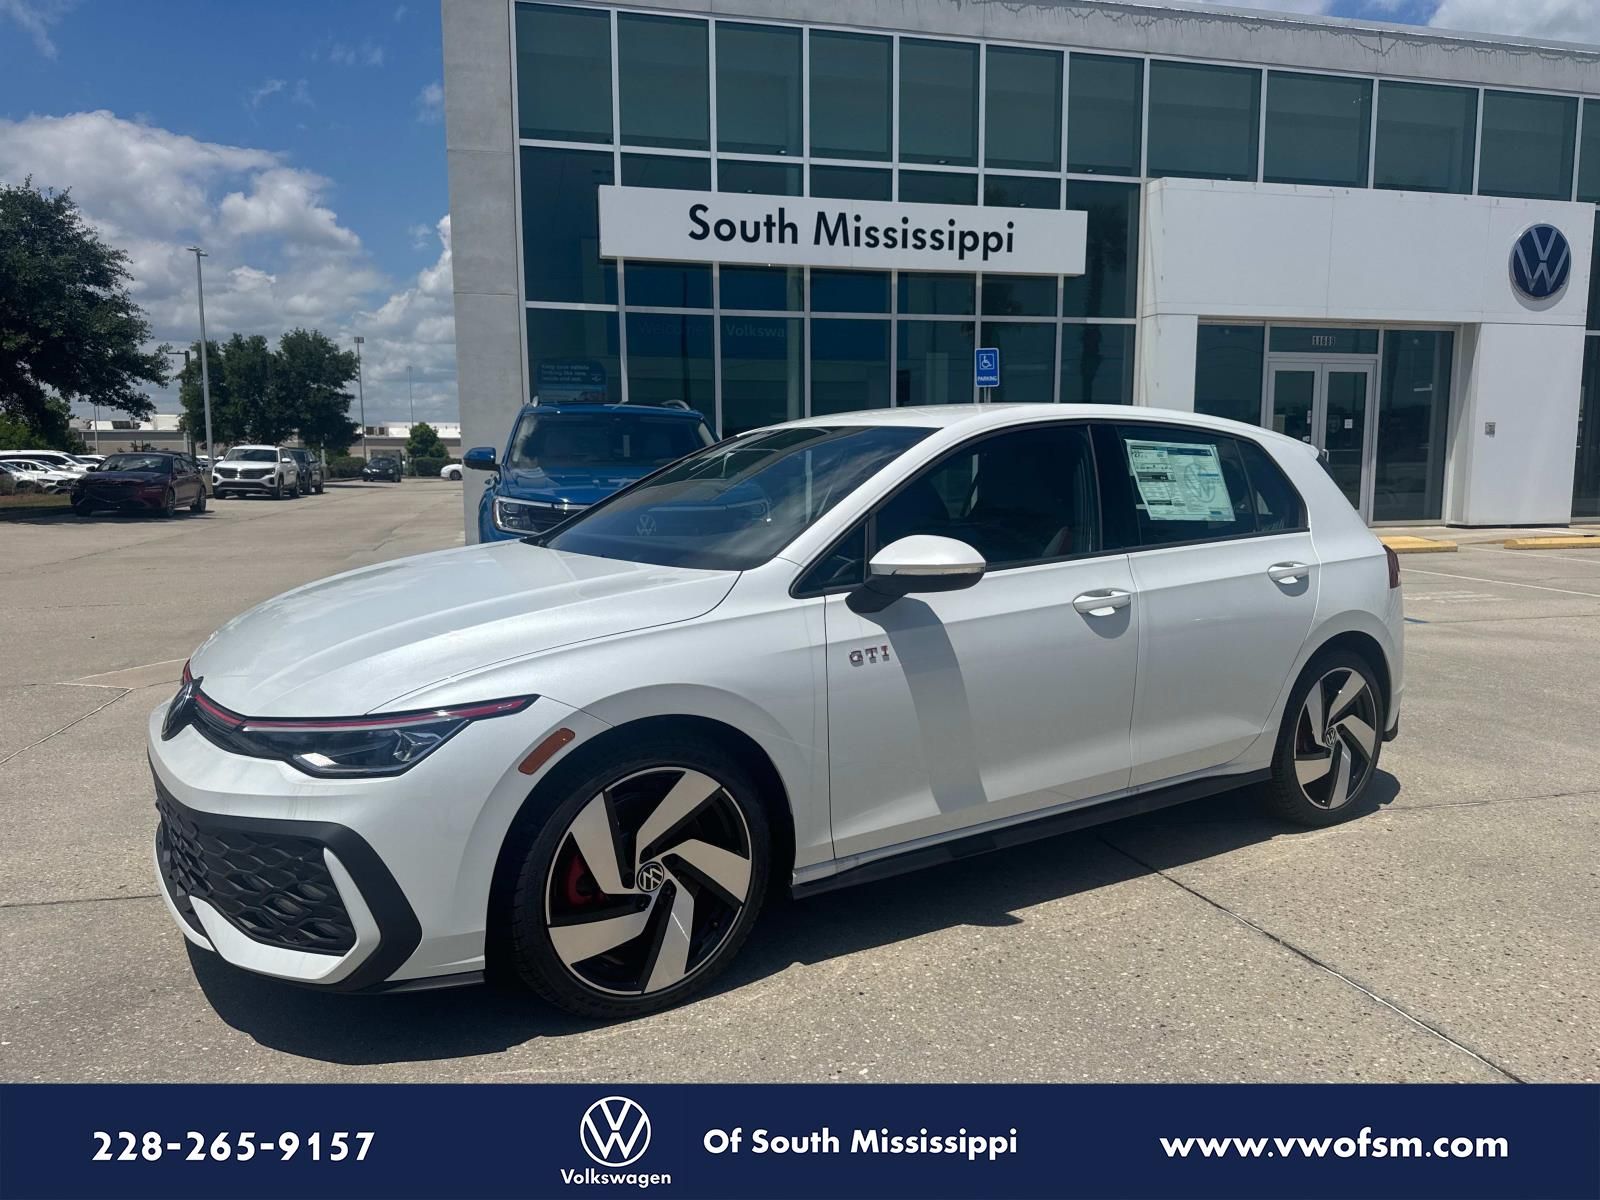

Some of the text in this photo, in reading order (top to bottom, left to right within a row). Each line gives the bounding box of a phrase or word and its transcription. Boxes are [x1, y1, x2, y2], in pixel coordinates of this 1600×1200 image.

[688, 203, 1015, 261] South Mississippi
[1513, 225, 1571, 295] VW
[849, 645, 889, 664] GTI
